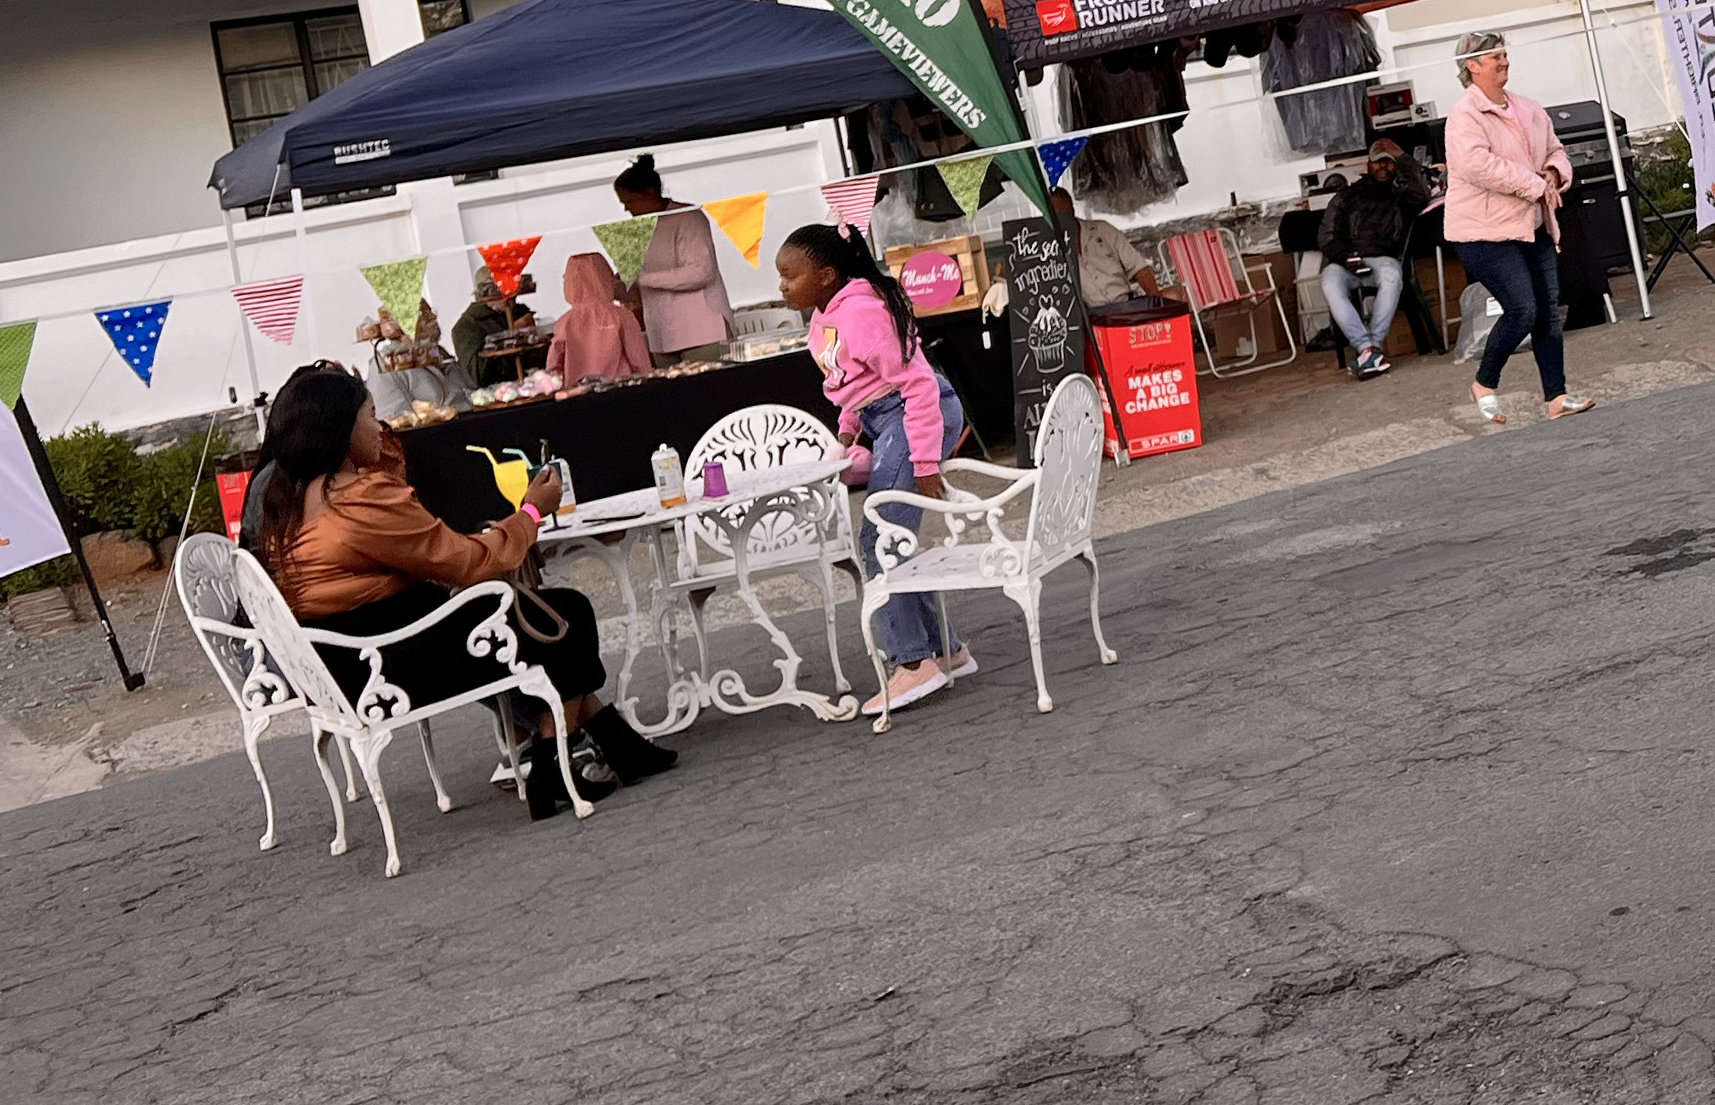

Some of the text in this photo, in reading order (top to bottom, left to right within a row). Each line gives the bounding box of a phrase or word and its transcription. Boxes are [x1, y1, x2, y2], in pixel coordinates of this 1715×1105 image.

[1012, 227, 1038, 257] the
[1129, 322, 1171, 344] STOP!
[1128, 369, 1183, 390] MAKES
[1136, 382, 1178, 400] A BIG
[1125, 392, 1191, 415] CHANGE
[1141, 433, 1178, 450] SPAR
